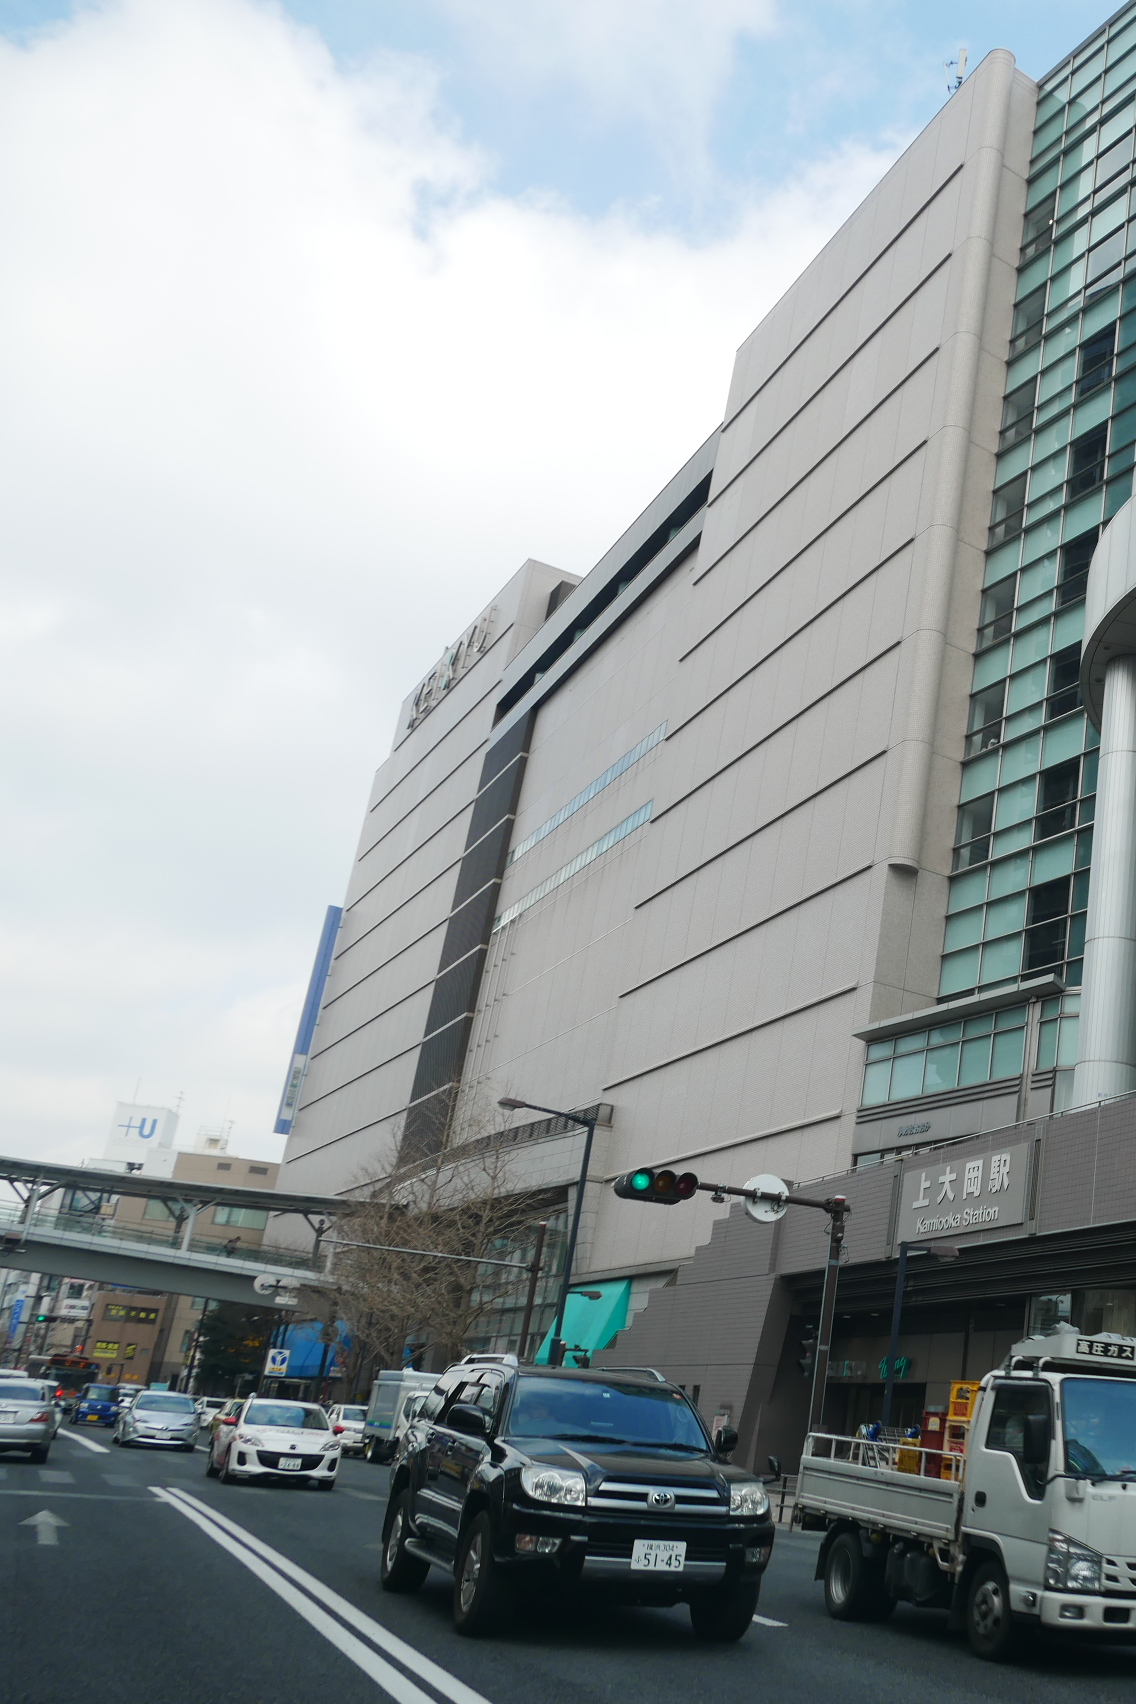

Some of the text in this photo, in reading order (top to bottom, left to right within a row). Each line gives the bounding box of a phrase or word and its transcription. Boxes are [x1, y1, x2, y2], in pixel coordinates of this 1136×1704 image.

[912, 1152, 1011, 1210] 上大岡駅
[915, 1205, 999, 1235] Kamiooka Station
[1077, 1340, 1133, 1358] 高圧ガス
[643, 1552, 683, 1569] 51-45
